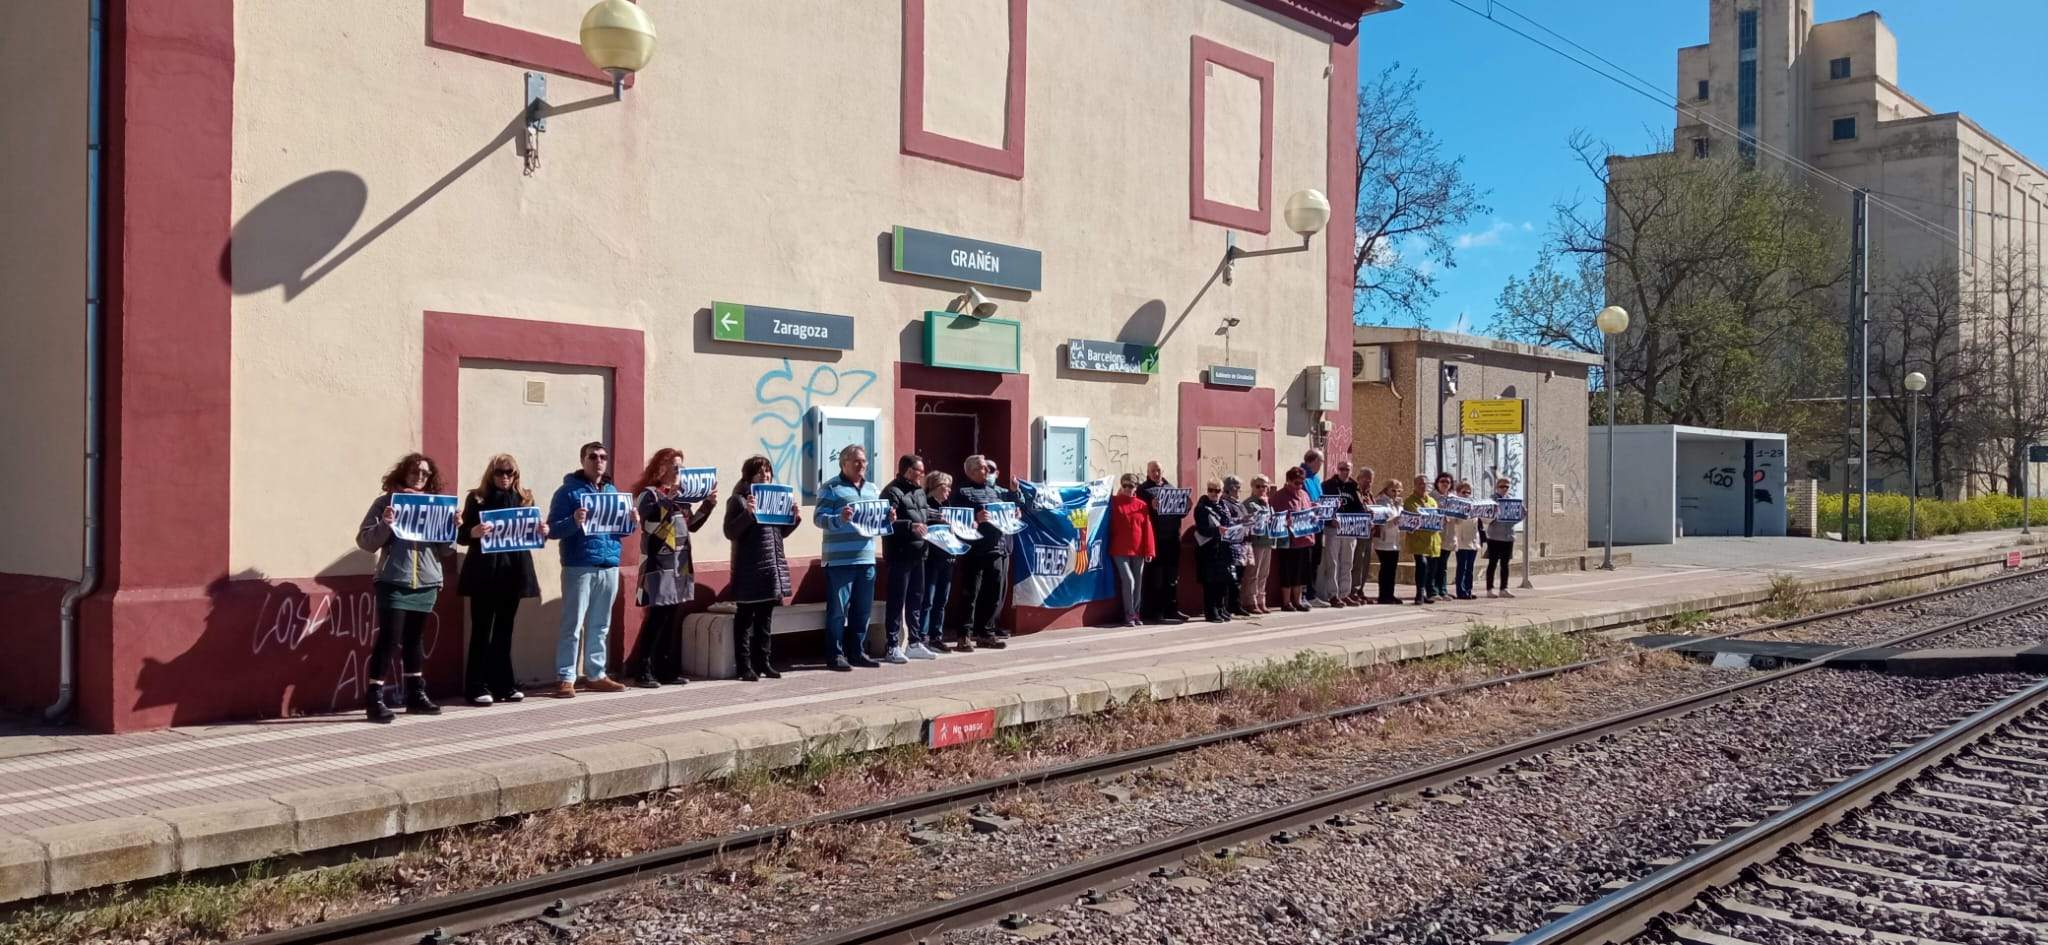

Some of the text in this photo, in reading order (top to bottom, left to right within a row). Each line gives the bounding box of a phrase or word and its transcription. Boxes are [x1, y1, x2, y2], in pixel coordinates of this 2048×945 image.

[950, 249, 999, 273] GRAÑÉN
[773, 319, 828, 340] Zaragoza
[481, 509, 543, 549] GRAÑÉN
[851, 502, 888, 534] CURBE
